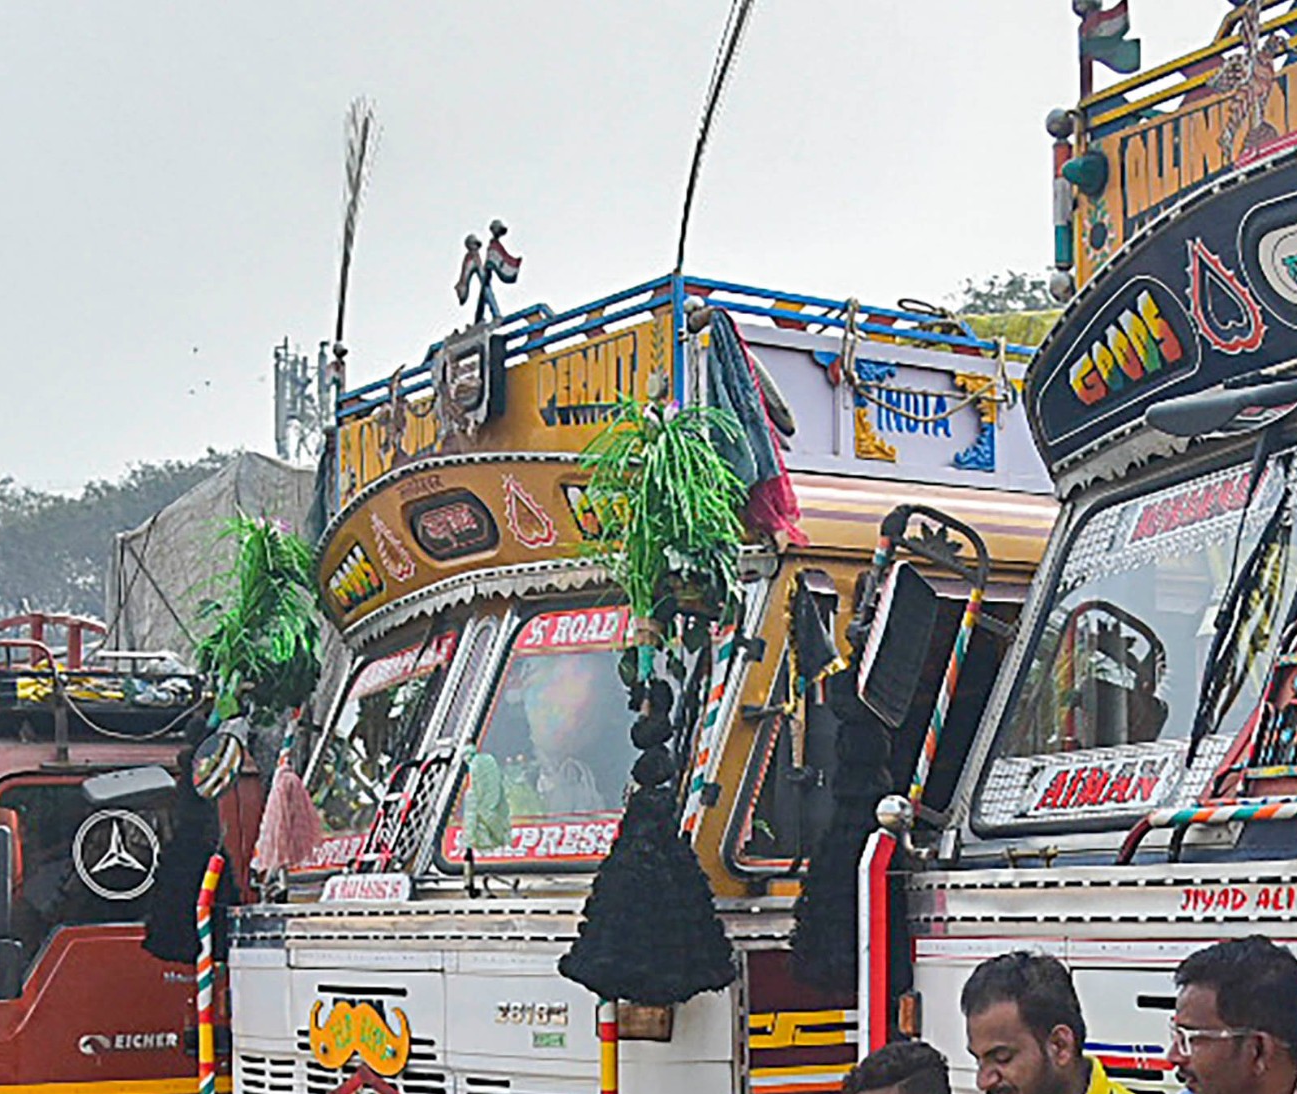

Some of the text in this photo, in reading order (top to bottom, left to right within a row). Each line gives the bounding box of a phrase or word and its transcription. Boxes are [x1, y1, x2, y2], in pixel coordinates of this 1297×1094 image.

[1069, 290, 1184, 406] GOODS
[538, 334, 635, 410] PERMIT
[876, 385, 952, 438] INDIA
[552, 611, 620, 645] ROAD
[478, 823, 617, 858] PRESS
[1254, 886, 1295, 911] ALI
[113, 1032, 179, 1050] EICHER
